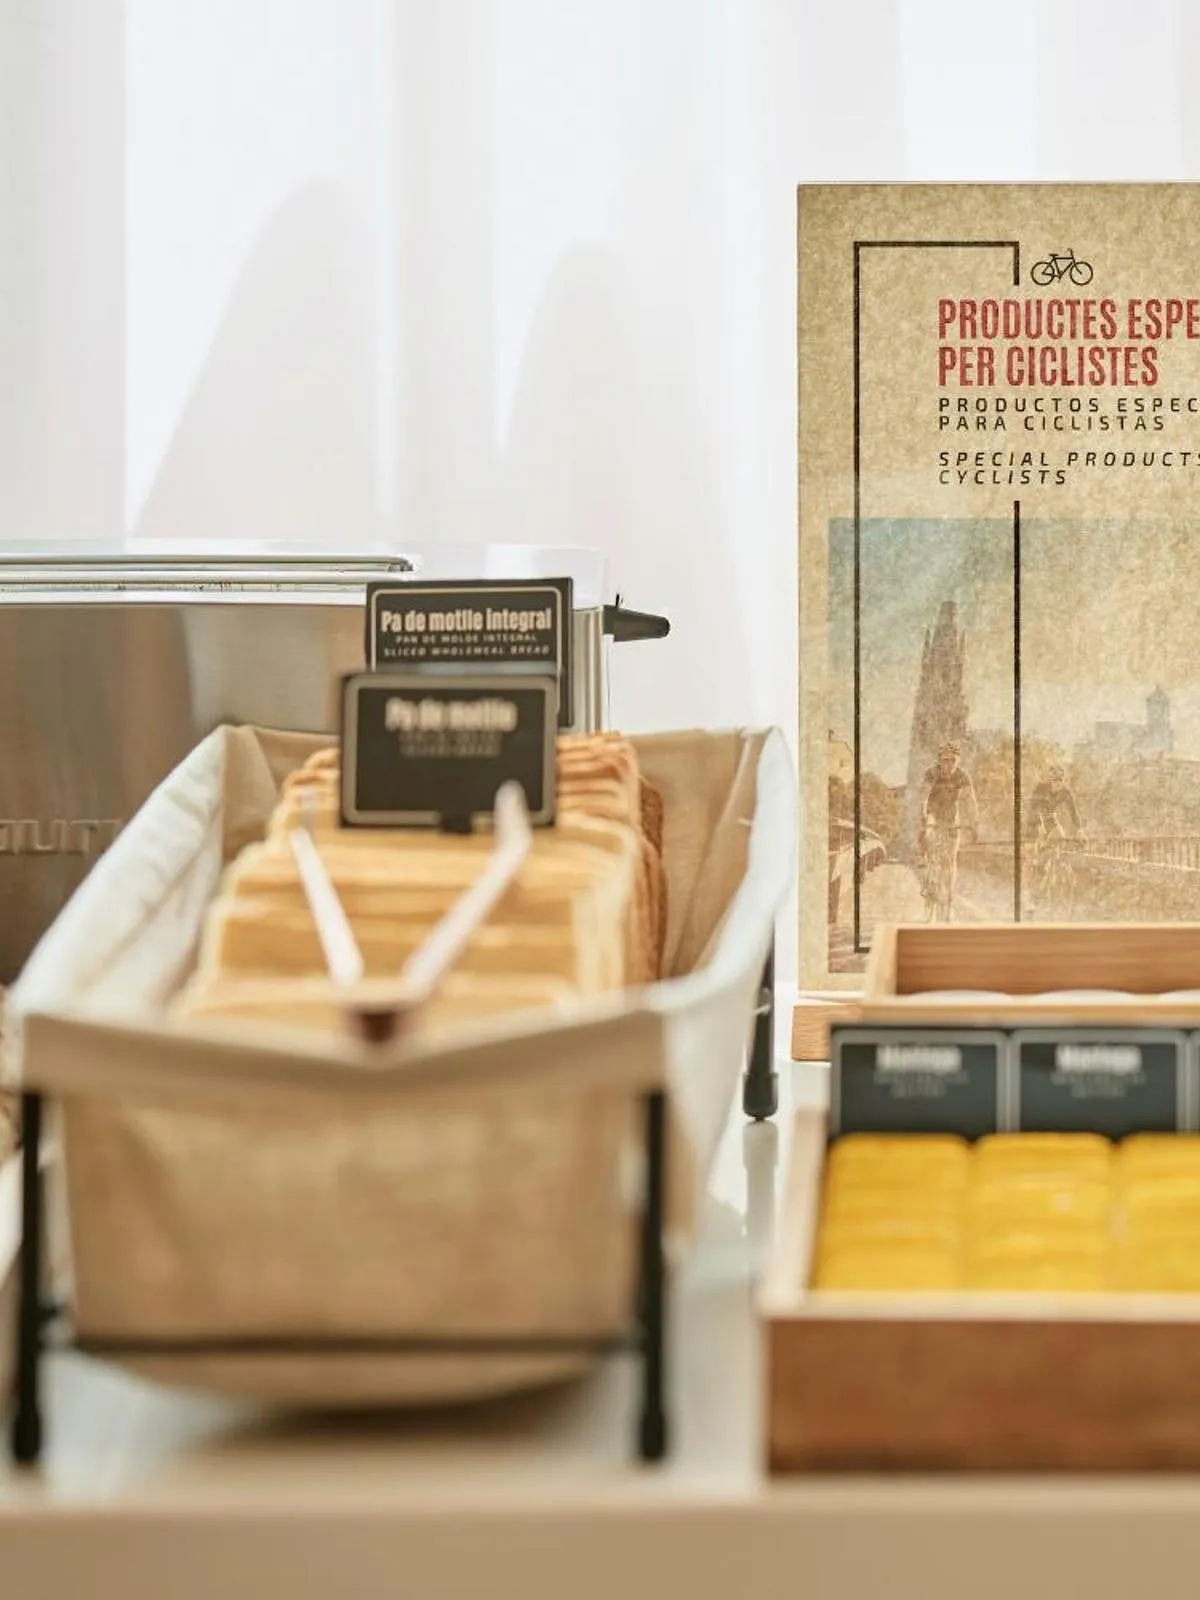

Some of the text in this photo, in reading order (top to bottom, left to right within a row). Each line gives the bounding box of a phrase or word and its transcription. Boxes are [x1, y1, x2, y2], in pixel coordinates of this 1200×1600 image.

[939, 299, 1118, 341] PRODUCTES
[939, 346, 1159, 387] PER CICLISTES
[939, 397, 1099, 413] PRODUCTOS
[939, 415, 1165, 431] PARA CICLISTAS
[939, 451, 1049, 467] SPECIAL
[939, 469, 1068, 485] CYCLISTS
[381, 610, 402, 632] Pa
[404, 610, 426, 632] de
[485, 607, 552, 631] integral
